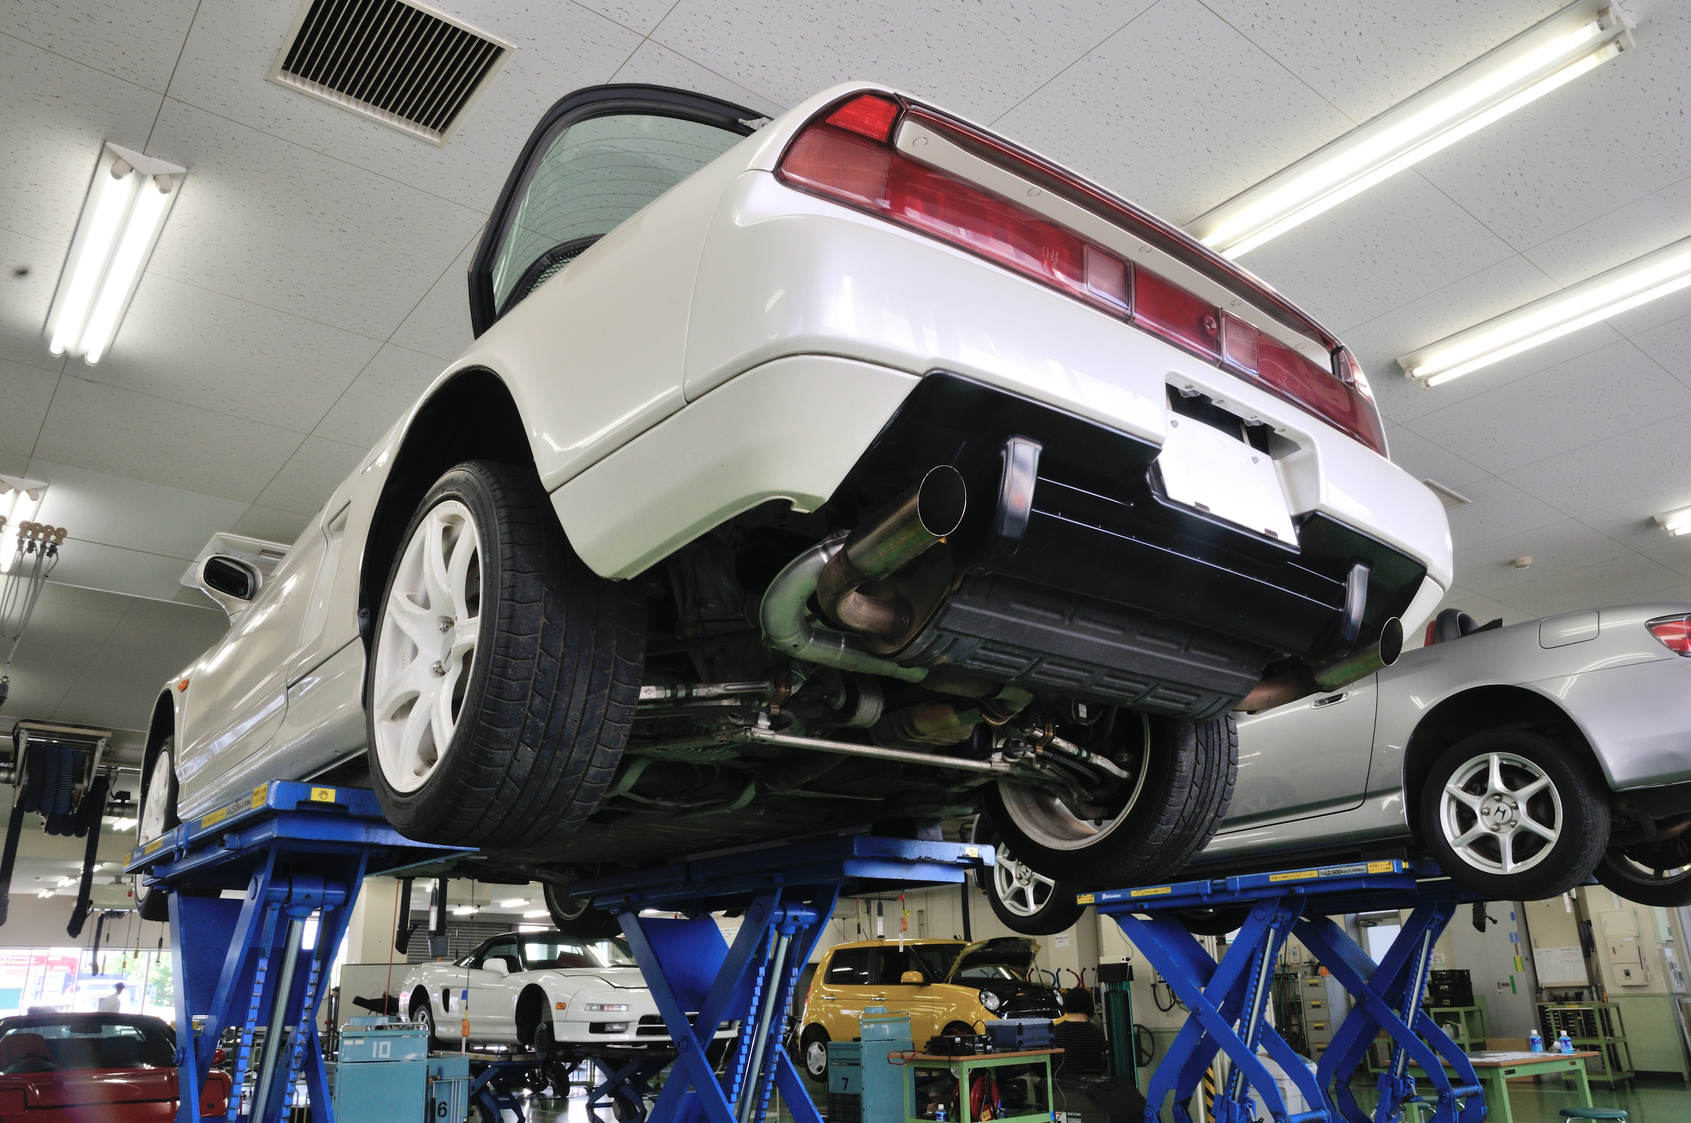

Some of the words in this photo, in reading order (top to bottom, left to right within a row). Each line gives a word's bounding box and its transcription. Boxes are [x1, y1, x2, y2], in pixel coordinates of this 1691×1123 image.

[882, 1024, 889, 1035] 7
[372, 1041, 391, 1058] 10
[842, 1077, 849, 1090] 7
[437, 1101, 448, 1118] 6
